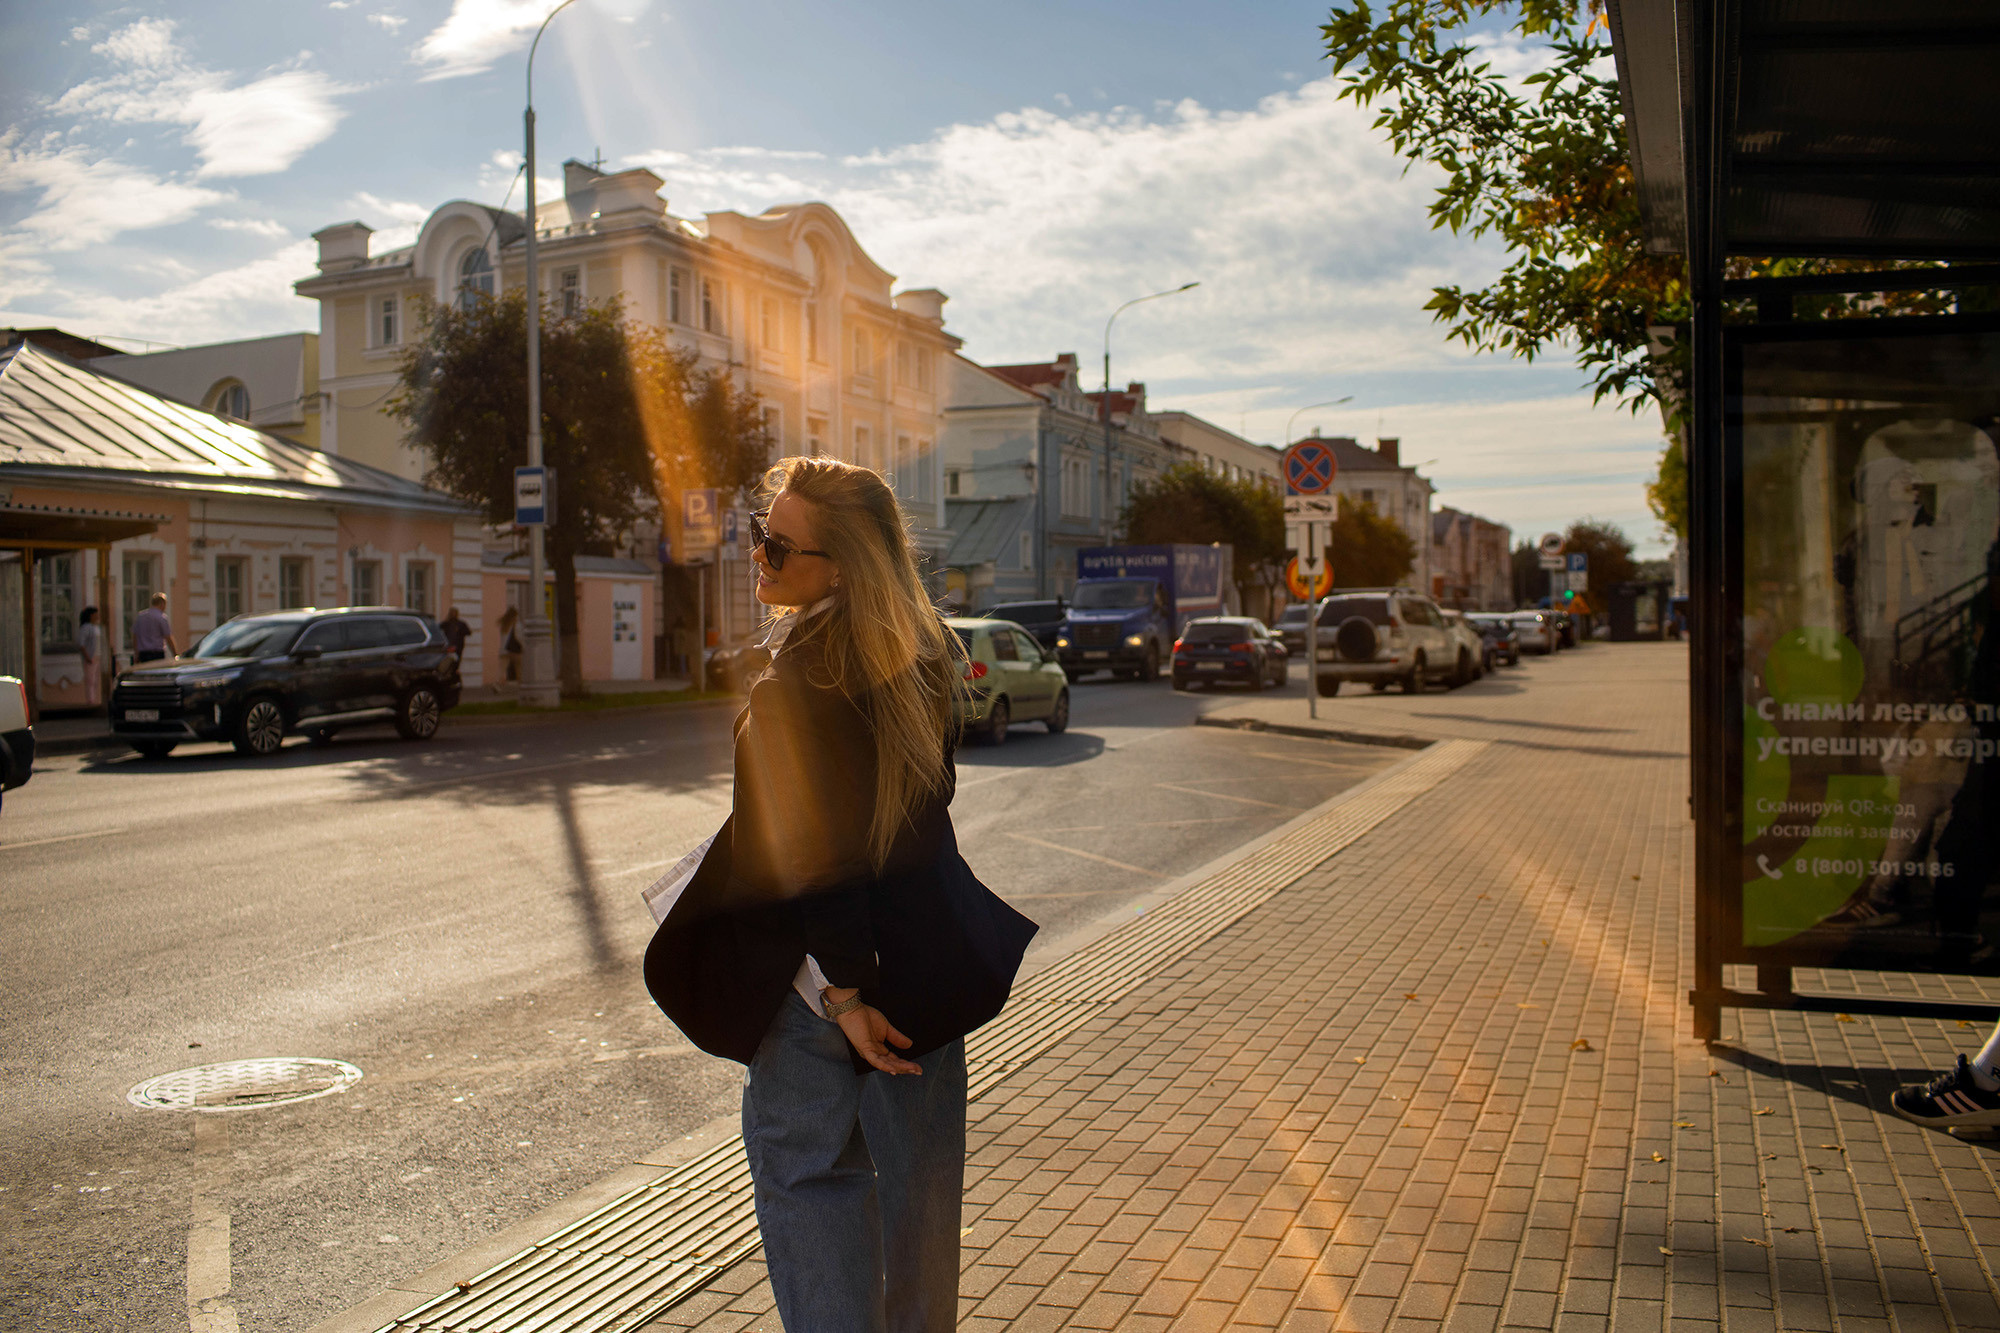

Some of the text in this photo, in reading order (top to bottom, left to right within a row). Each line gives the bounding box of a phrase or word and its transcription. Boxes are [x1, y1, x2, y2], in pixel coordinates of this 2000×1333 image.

[1757, 697, 1775, 721] С
[1782, 703, 1865, 721] нами
[1872, 703, 1967, 722] легко
[1757, 737, 2000, 764] успешную кар
[1757, 798, 1916, 818] Сканируй QR-код
[1757, 823, 1921, 843] и оставляй заявку
[1795, 859, 1807, 873] 8
[1812, 857, 1864, 878] (800)
